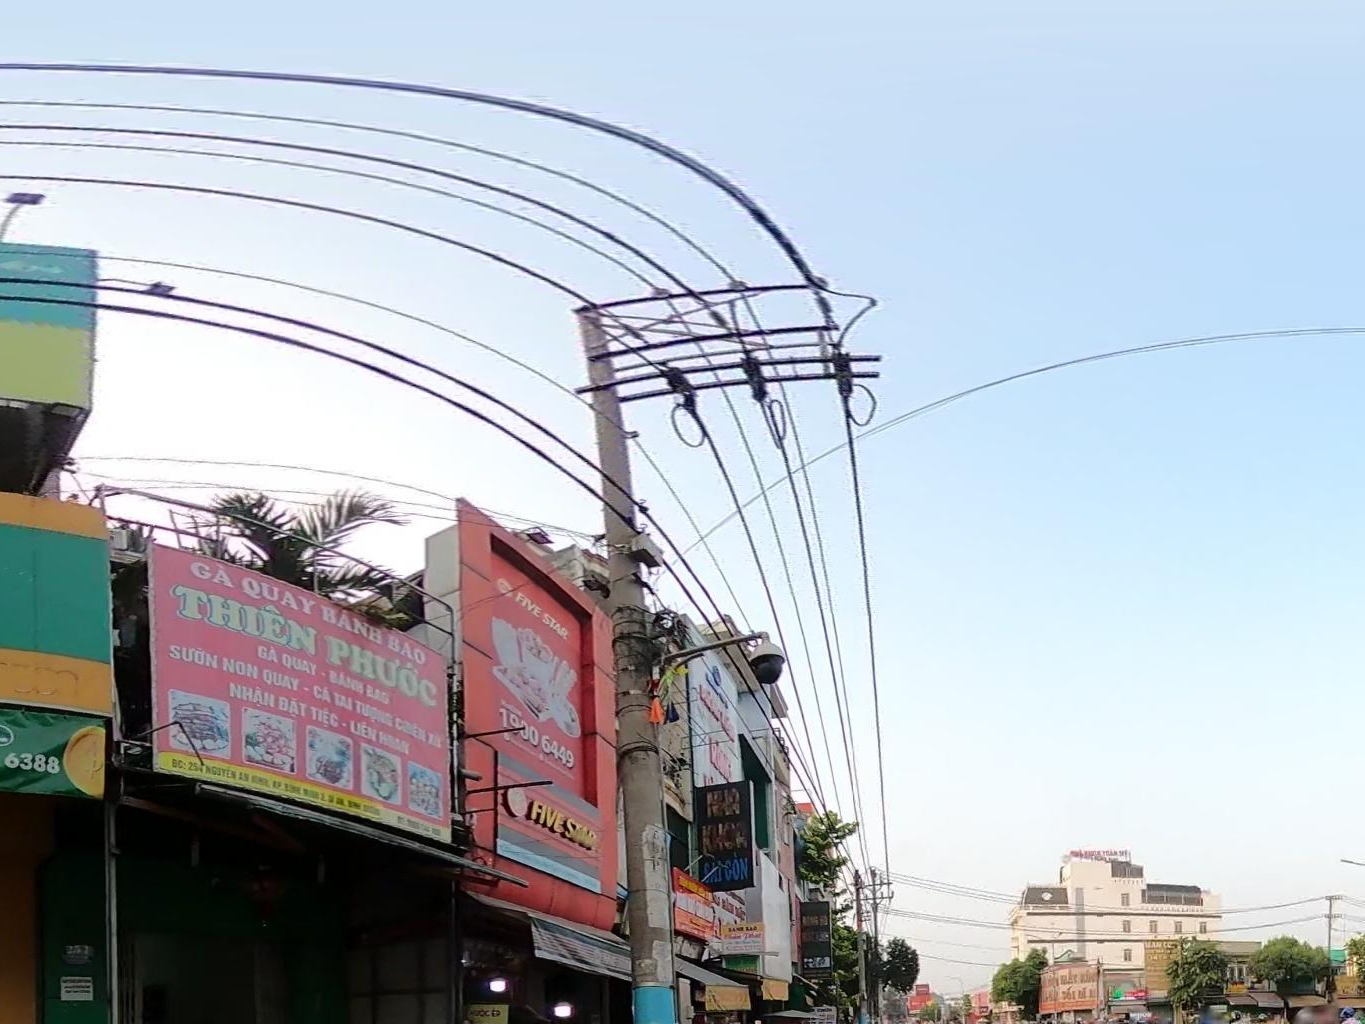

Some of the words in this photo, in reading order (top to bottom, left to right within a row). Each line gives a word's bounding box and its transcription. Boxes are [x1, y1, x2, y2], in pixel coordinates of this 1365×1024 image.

[171, 583, 317, 656] THIÊN
[189, 558, 234, 588] GÀ
[241, 577, 316, 615] QUAY
[388, 637, 426, 665] BAO
[516, 592, 542, 617] FIVE
[542, 613, 568, 640] STAR
[169, 645, 218, 669] SƯỜN
[222, 657, 259, 680] NON
[262, 669, 300, 692] QUAY
[257, 645, 278, 662] GÀ
[282, 653, 317, 676] QUAY
[228, 682, 275, 708] NHẬN
[4, 751, 62, 775] 6388
[541, 735, 575, 769] 6449
[530, 799, 565, 833] FIVE
